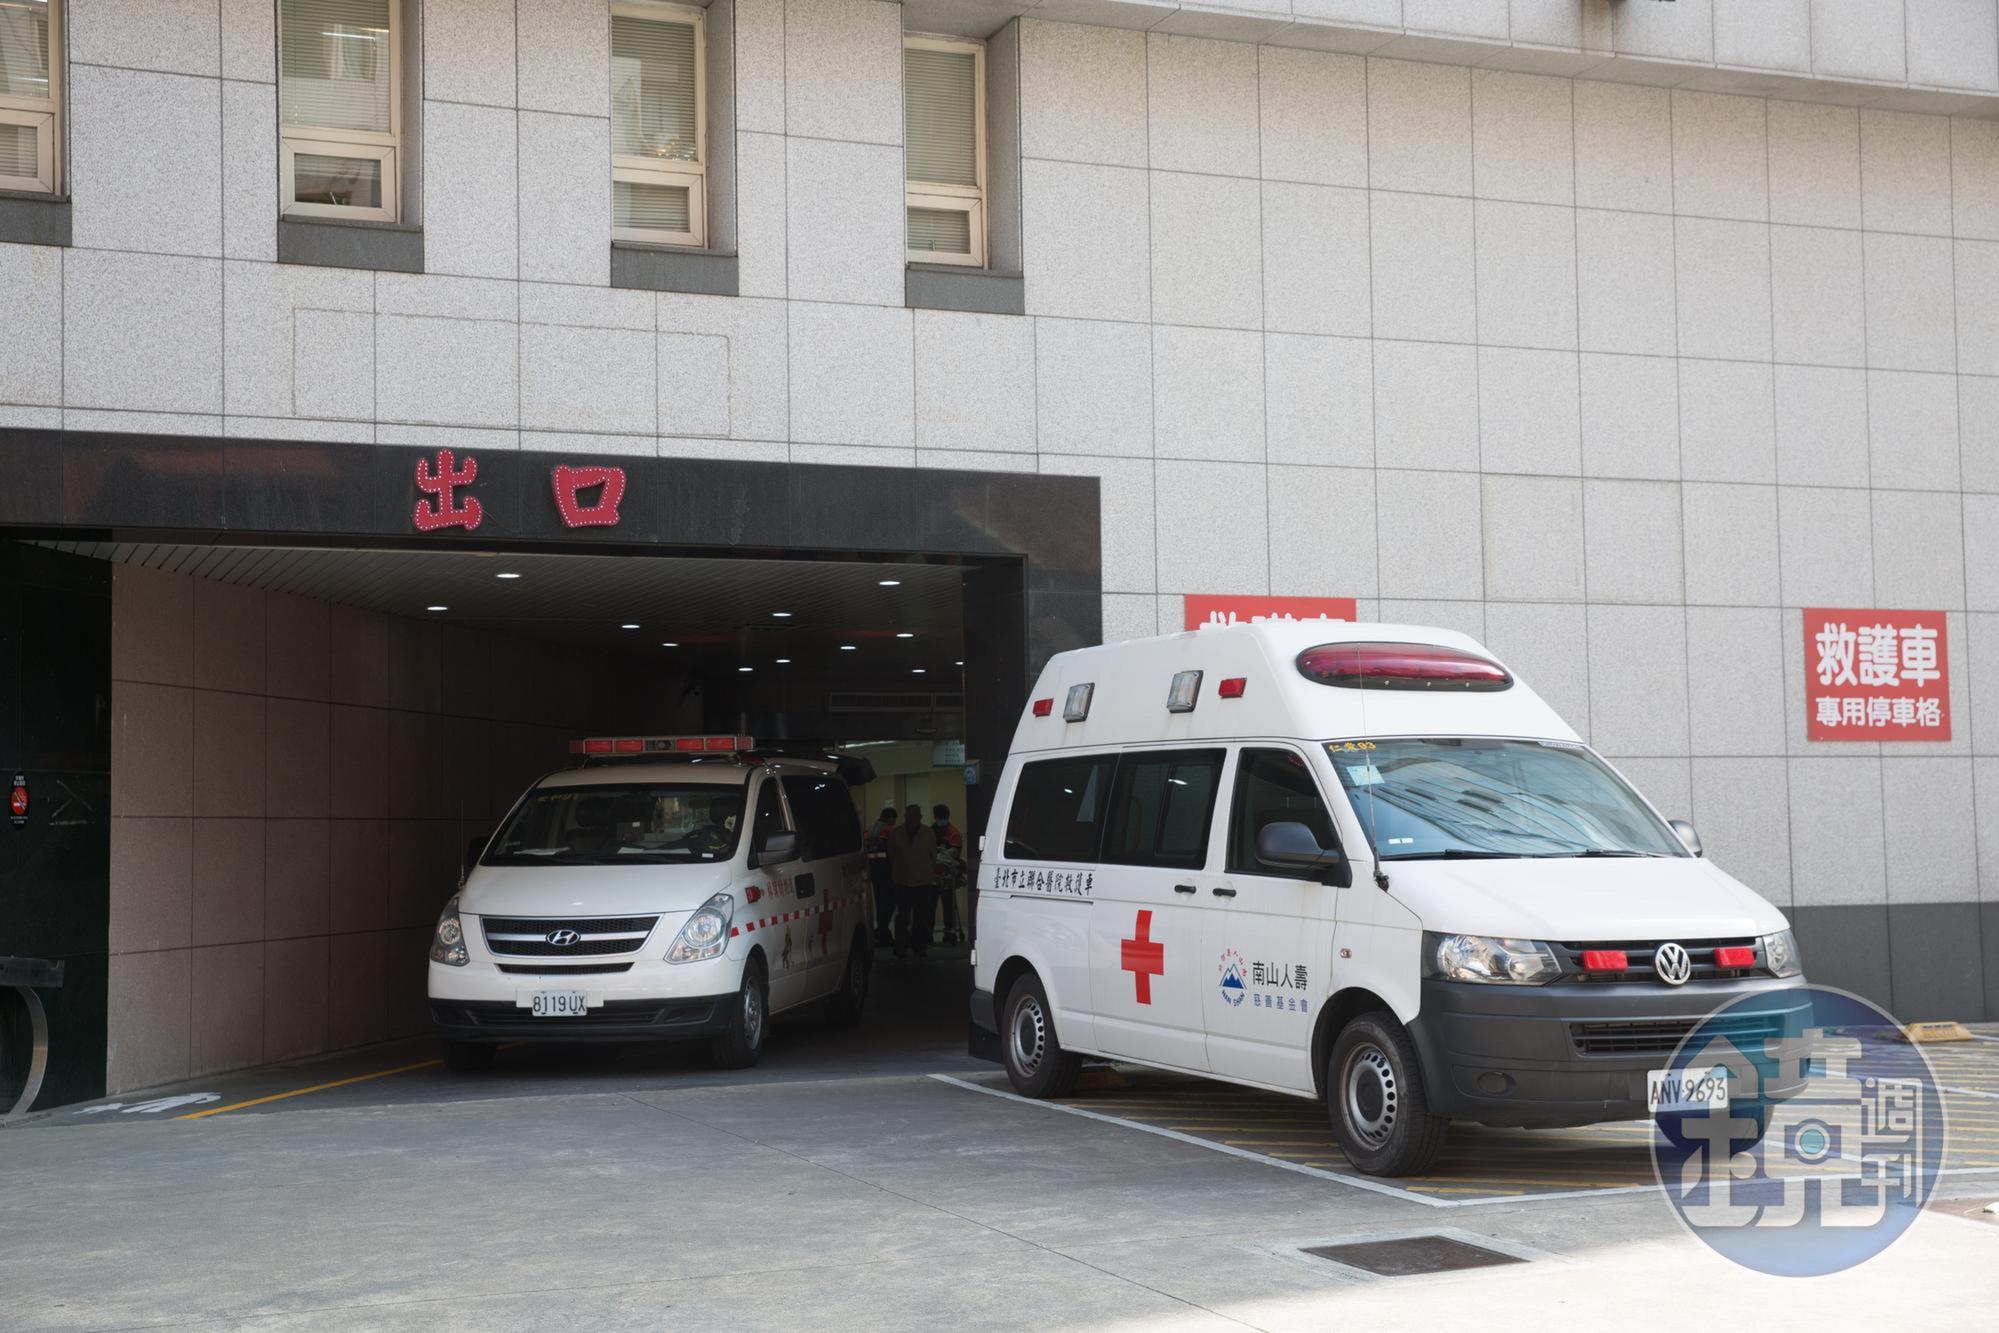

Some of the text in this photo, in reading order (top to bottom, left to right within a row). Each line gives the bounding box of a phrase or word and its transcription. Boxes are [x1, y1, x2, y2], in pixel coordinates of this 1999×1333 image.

[412, 448, 627, 532] 出口
[1815, 622, 1942, 688] 救護車
[1815, 696, 1942, 727] 專用停車格
[1252, 961, 1308, 991] 南山人壽
